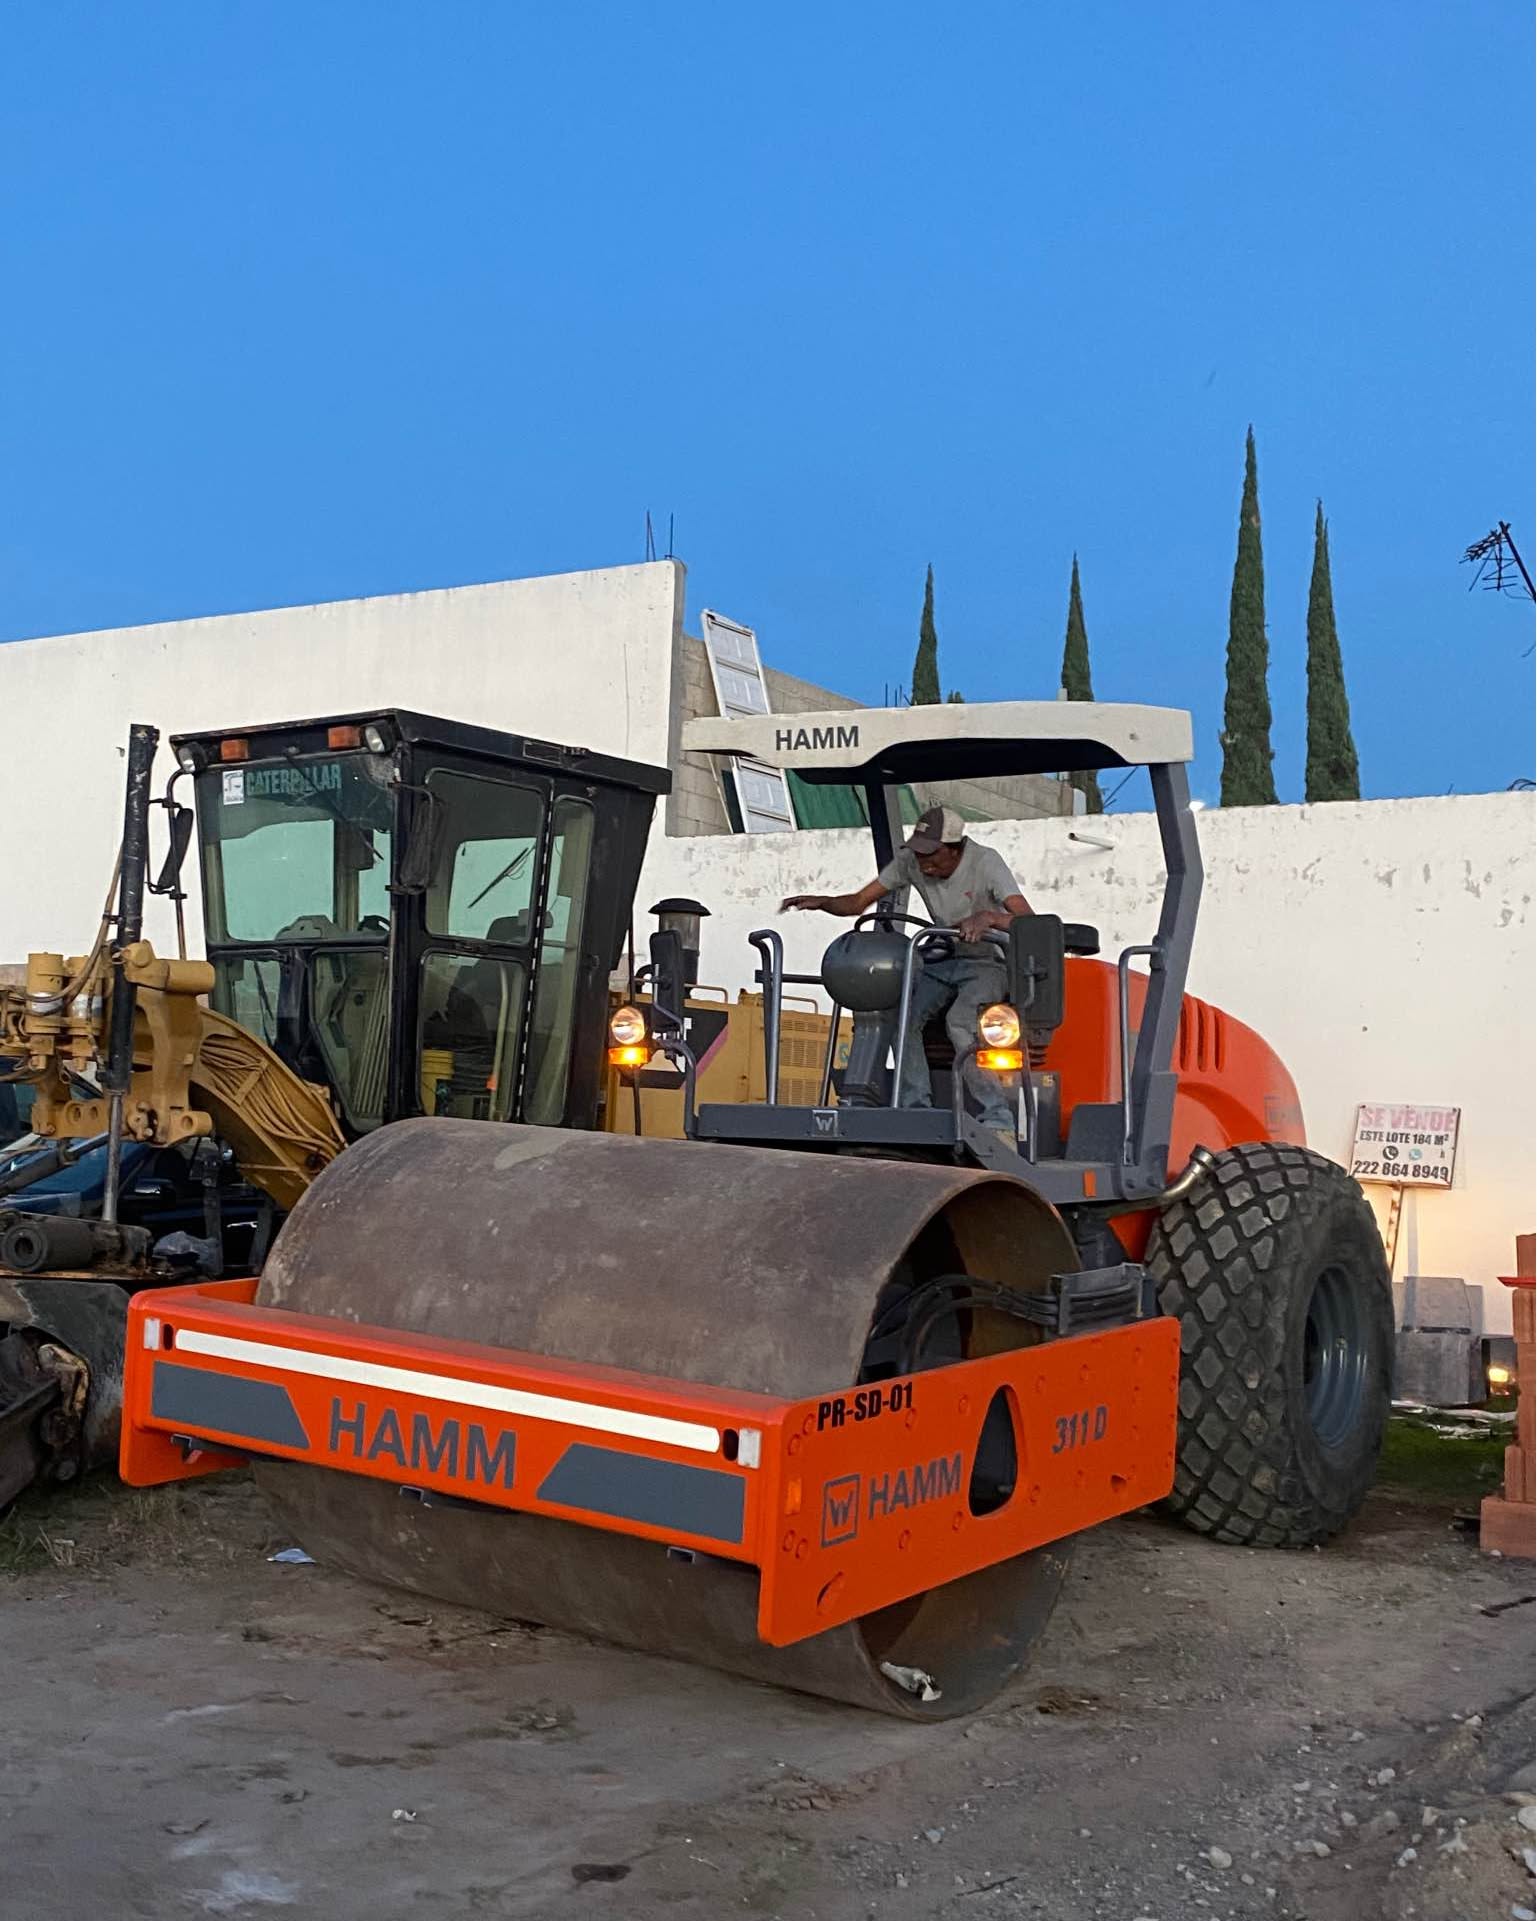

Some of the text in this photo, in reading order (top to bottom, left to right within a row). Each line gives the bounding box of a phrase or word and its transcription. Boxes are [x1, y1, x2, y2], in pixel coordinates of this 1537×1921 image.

[776, 725, 859, 751] HAMM
[1360, 1107, 1456, 1132] SE VENDE
[1360, 1130, 1384, 1142] ESTE
[1386, 1132, 1411, 1144] LOTE
[1353, 1160, 1449, 1181] 222 864 8949
[817, 1381, 913, 1431] PR-SD-01
[329, 1396, 517, 1490] HAMM
[868, 1452, 962, 1521] HAMM
